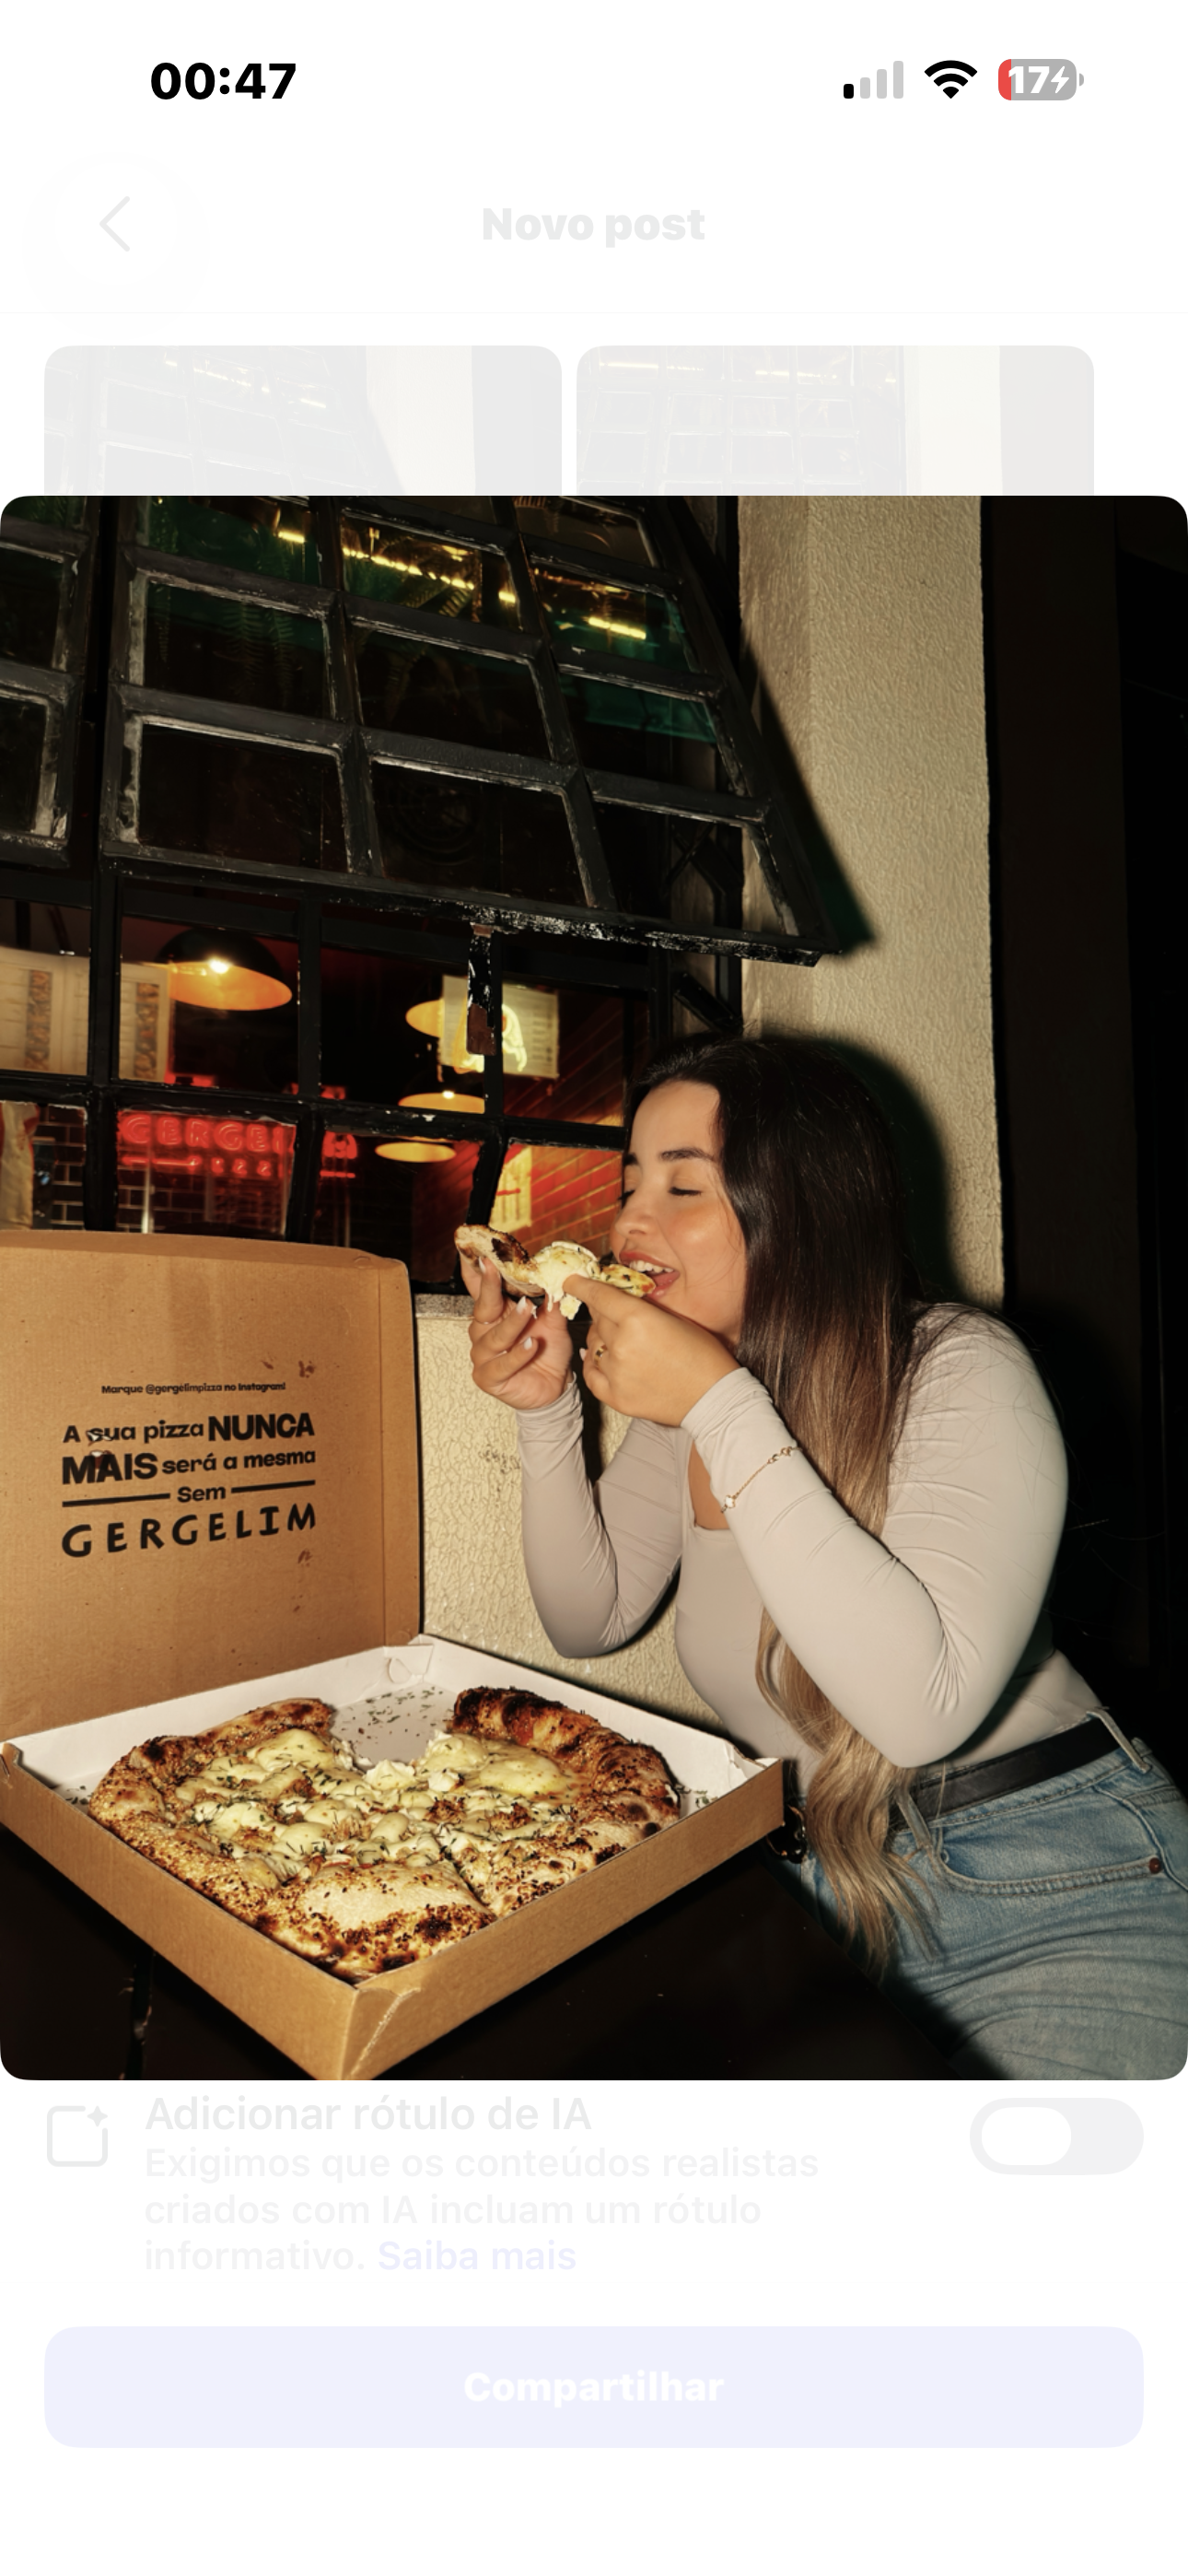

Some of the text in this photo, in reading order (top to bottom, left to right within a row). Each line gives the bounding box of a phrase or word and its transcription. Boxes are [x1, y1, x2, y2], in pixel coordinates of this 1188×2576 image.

[101, 1385, 143, 1395] Marque
[146, 1382, 222, 1395] @gergelimpizza
[224, 1383, 237, 1392] no
[63, 1412, 315, 1444] A sua pizza NUNCA
[62, 1449, 316, 1485] MAIS será a mesma
[177, 1486, 227, 1503] Sem
[62, 1503, 316, 1558] GERGELIM
